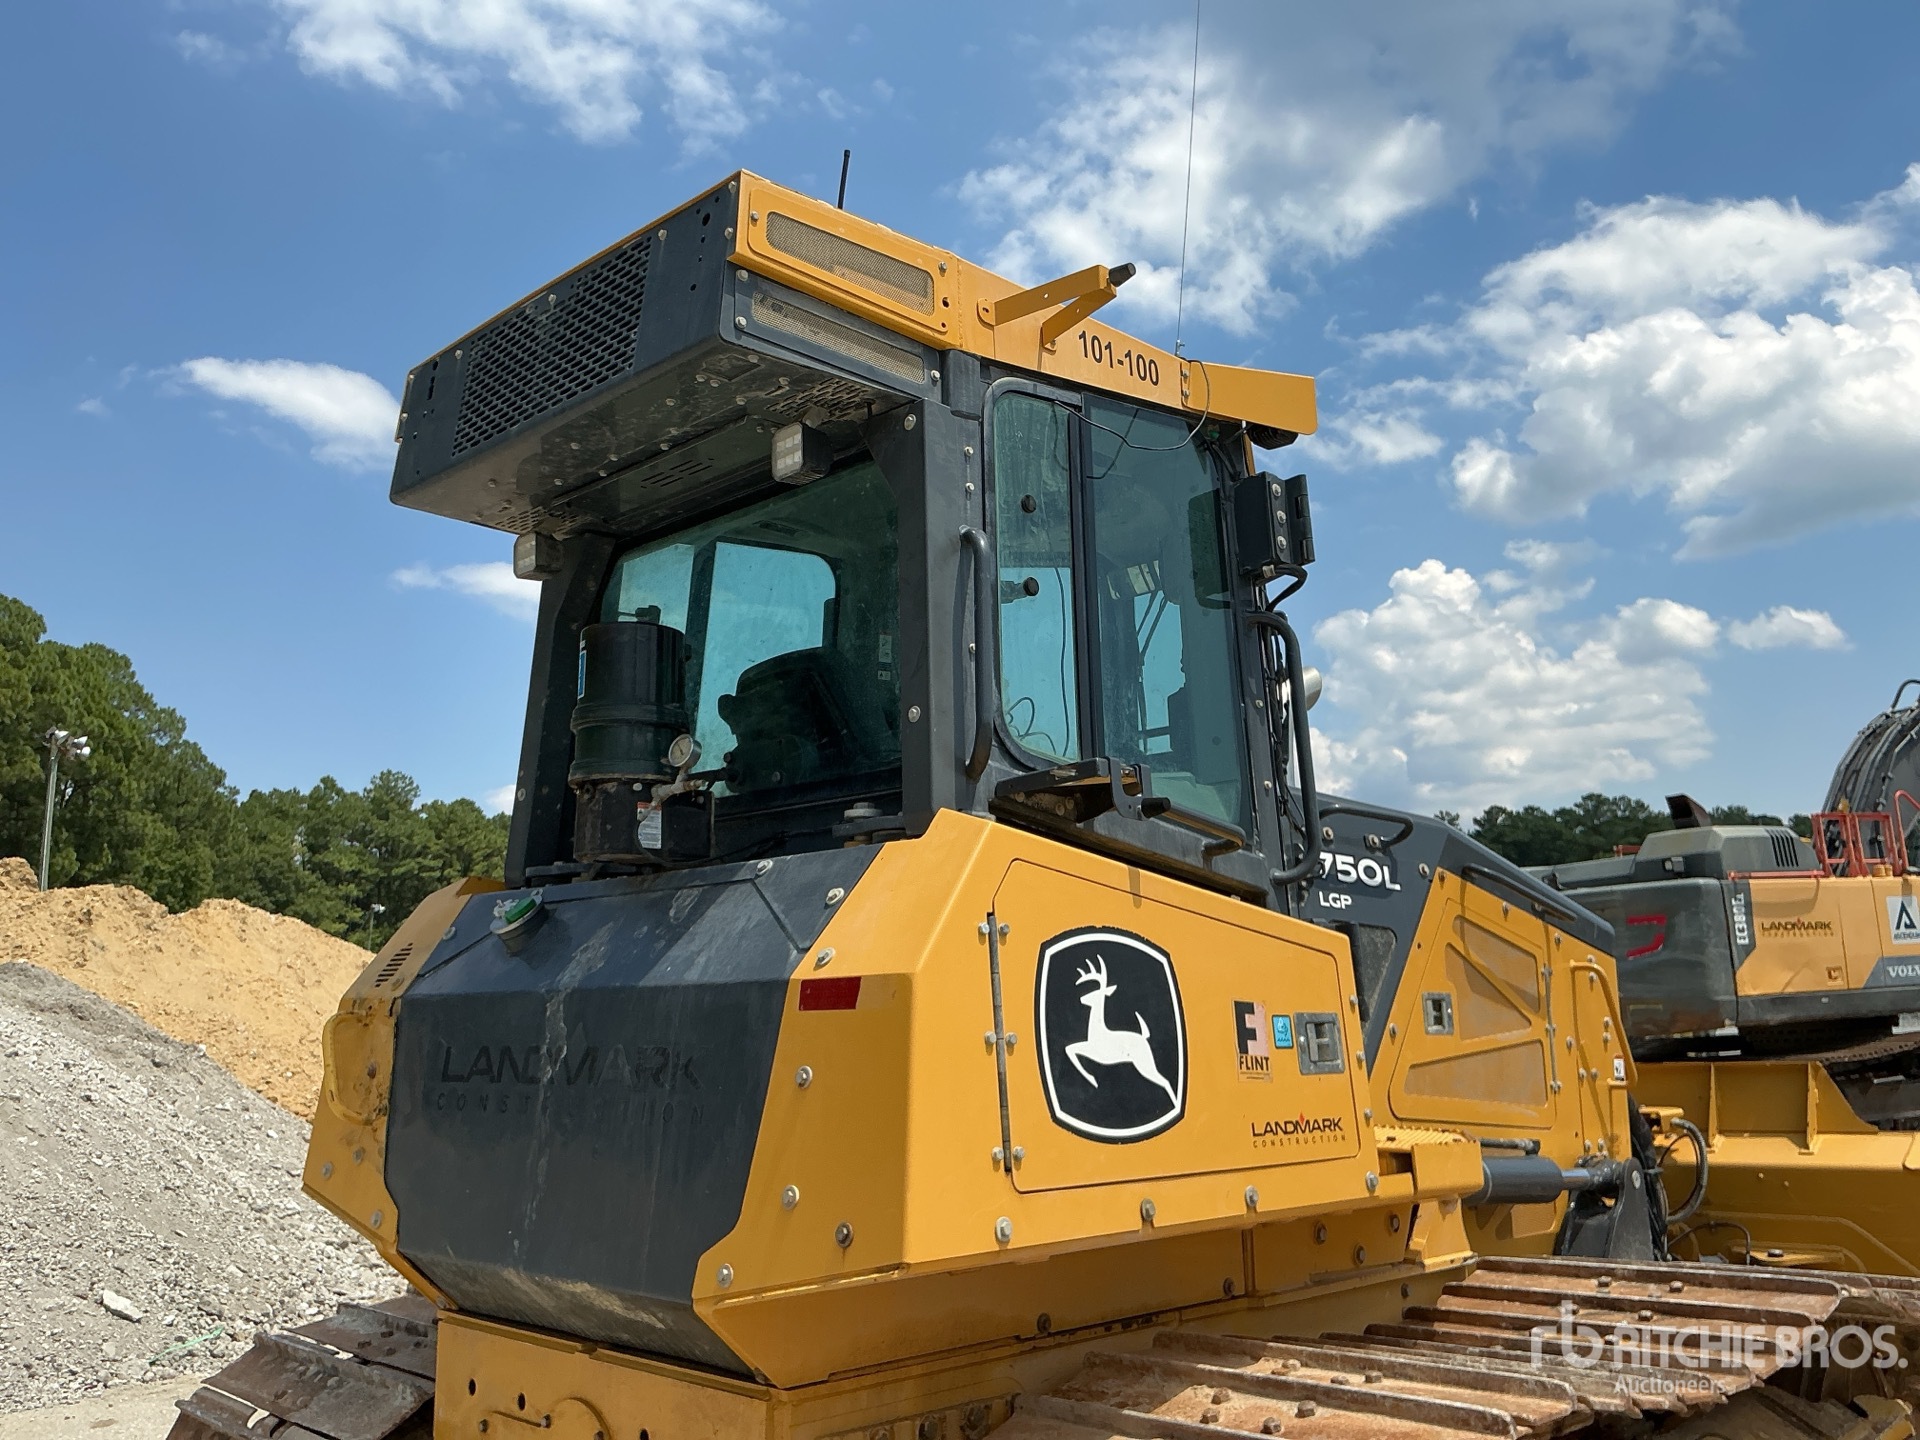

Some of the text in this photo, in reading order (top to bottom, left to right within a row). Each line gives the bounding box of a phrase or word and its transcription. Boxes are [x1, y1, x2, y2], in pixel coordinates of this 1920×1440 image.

[1078, 330, 1160, 387] 101-100
[1319, 851, 1402, 891] 750L
[1318, 890, 1353, 910] LGP
[1761, 920, 1832, 932] LANDMARK
[1239, 1055, 1270, 1072] FLINT
[1251, 1116, 1344, 1137] LANDMARK
[1252, 1134, 1347, 1149] CONSTRUCTION
